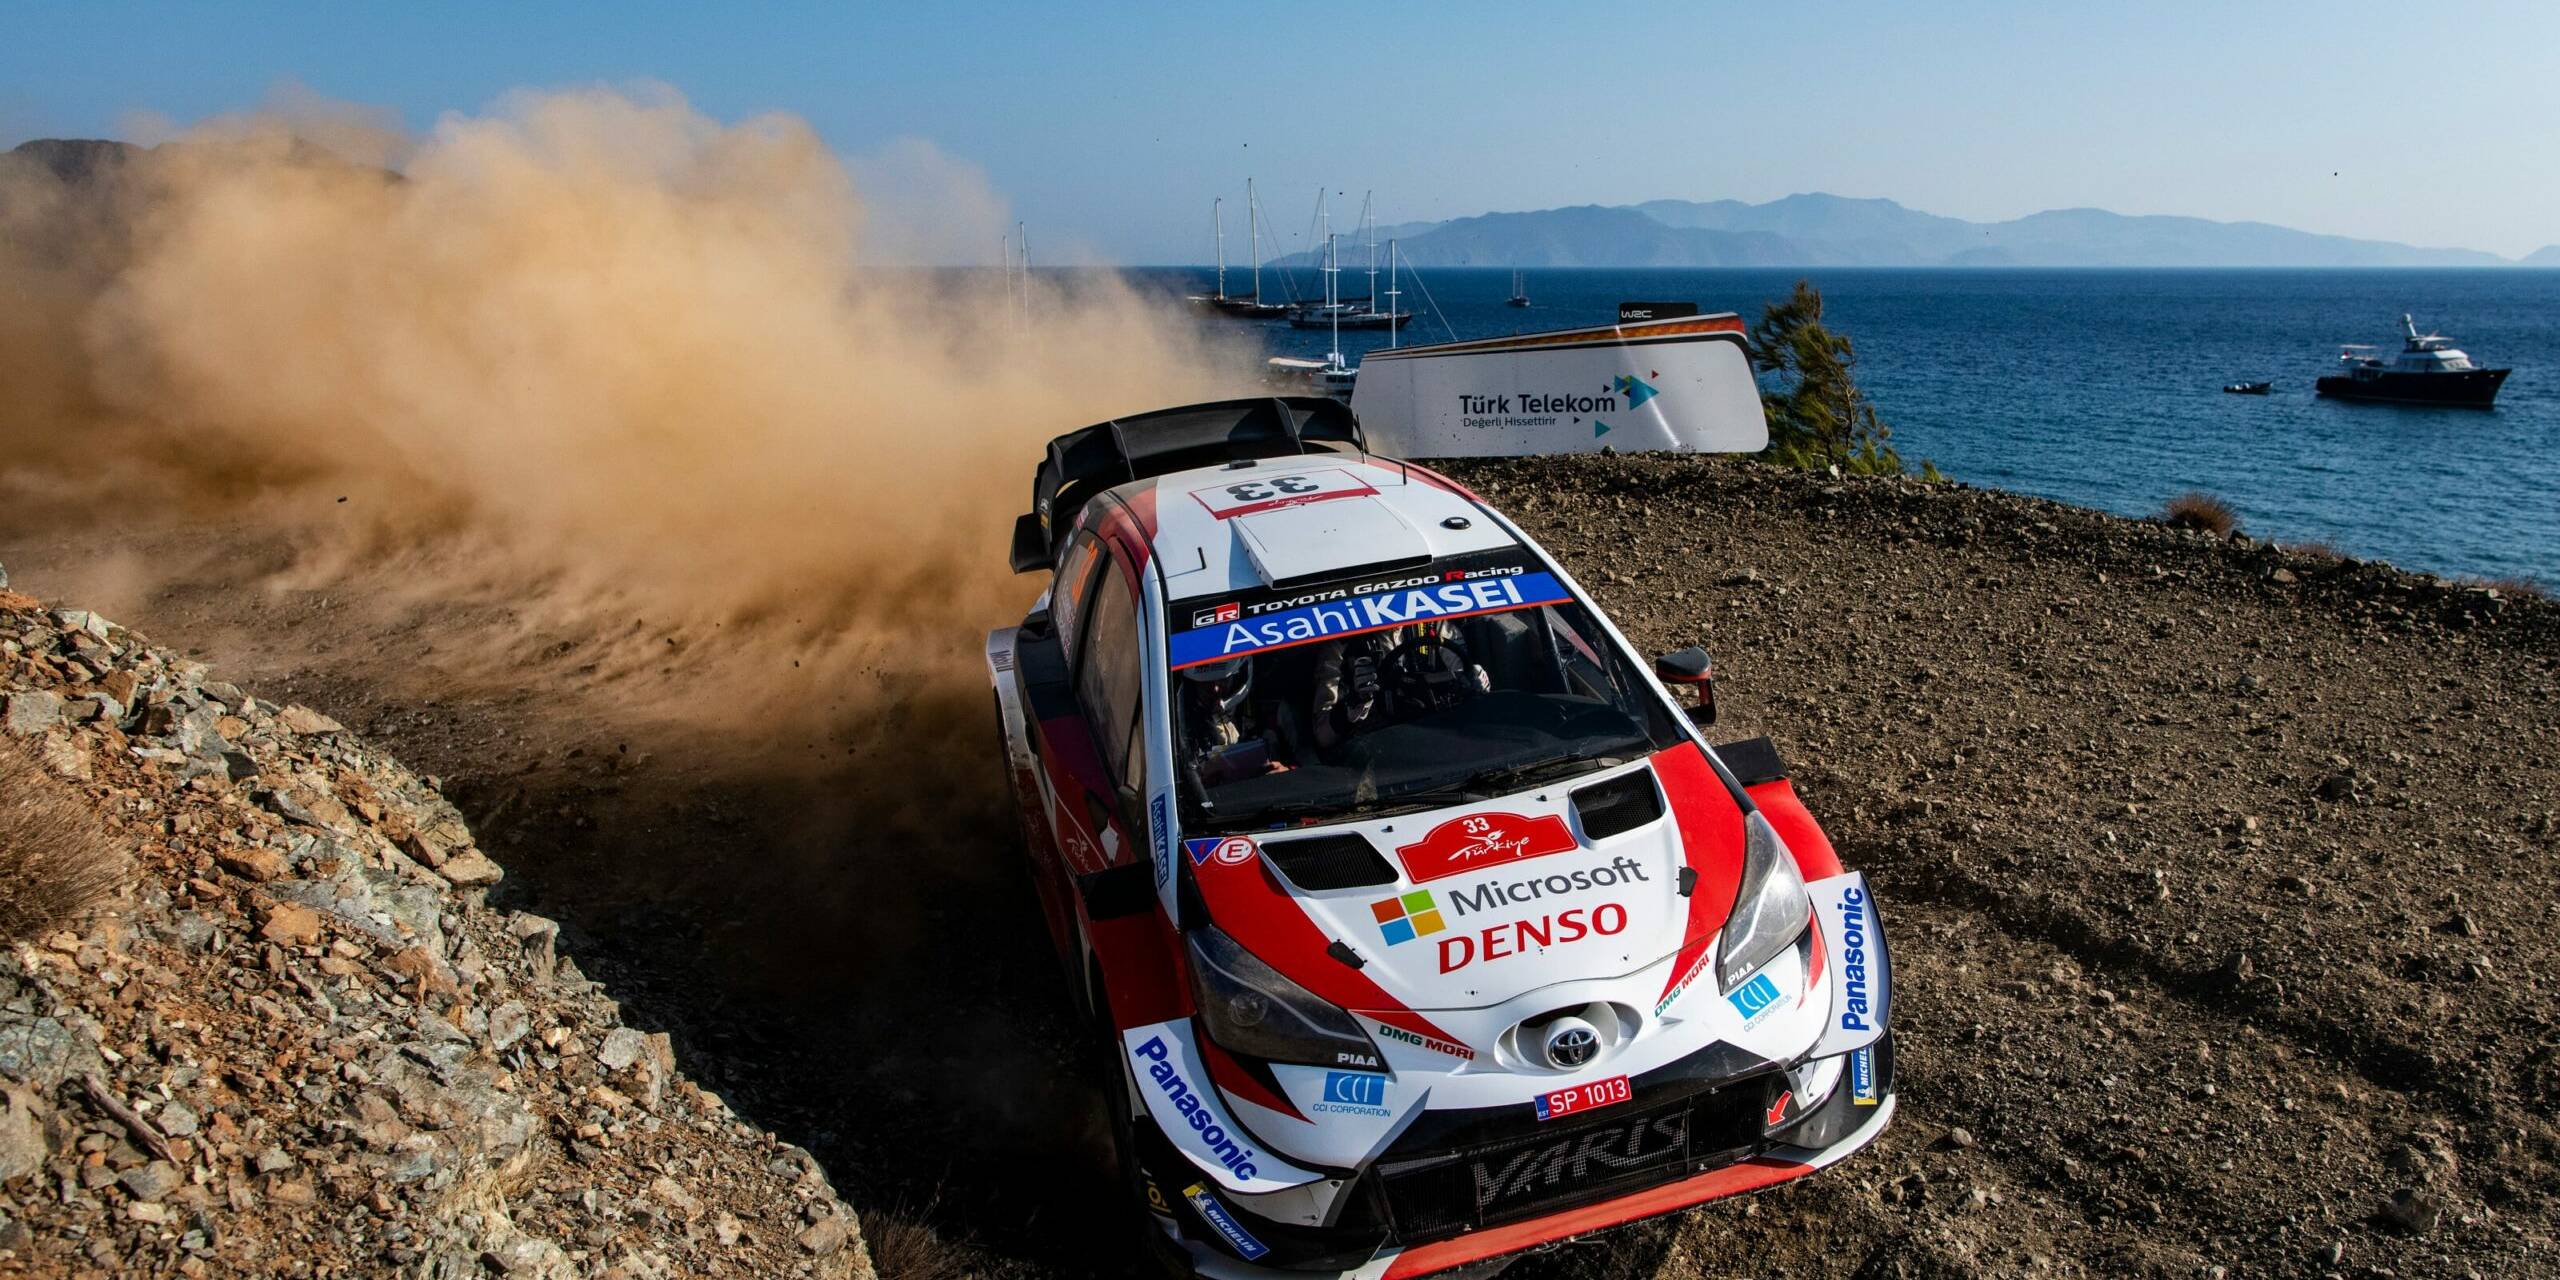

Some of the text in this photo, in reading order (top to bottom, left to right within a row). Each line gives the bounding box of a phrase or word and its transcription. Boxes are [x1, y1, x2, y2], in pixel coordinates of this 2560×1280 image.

[1621, 310, 1652, 319] WRC
[1459, 393, 1616, 415] Türk Telekom
[1463, 416, 1556, 428] Değerli Hissettirir
[1226, 476, 1319, 501] 33
[1247, 566, 1524, 614] TOYOTA GAZOO Racing
[1195, 609, 1238, 627] GR
[1462, 817, 1490, 834] 33
[1226, 843, 1244, 859] E
[1448, 856, 1649, 916] Microsoft
[1437, 903, 1628, 975] DENSO
[1727, 962, 1754, 986] PIAA
[1837, 887, 1870, 1031] Panasonic
[1655, 953, 1710, 1018] DMG MORI
[1379, 1024, 1475, 1061] DMG MORI
[1337, 1053, 1378, 1067] PIAA
[1859, 1048, 1869, 1086] MICHEL
[1336, 1074, 1370, 1103] CCI
[1550, 1079, 1627, 1113] SP 1013
[1134, 1035, 1258, 1181] Panasonic
[1312, 1104, 1391, 1117] CCI CORPORATION
[1472, 1110, 1692, 1206] YARIS
[1208, 1209, 1257, 1252] MICHELIN
